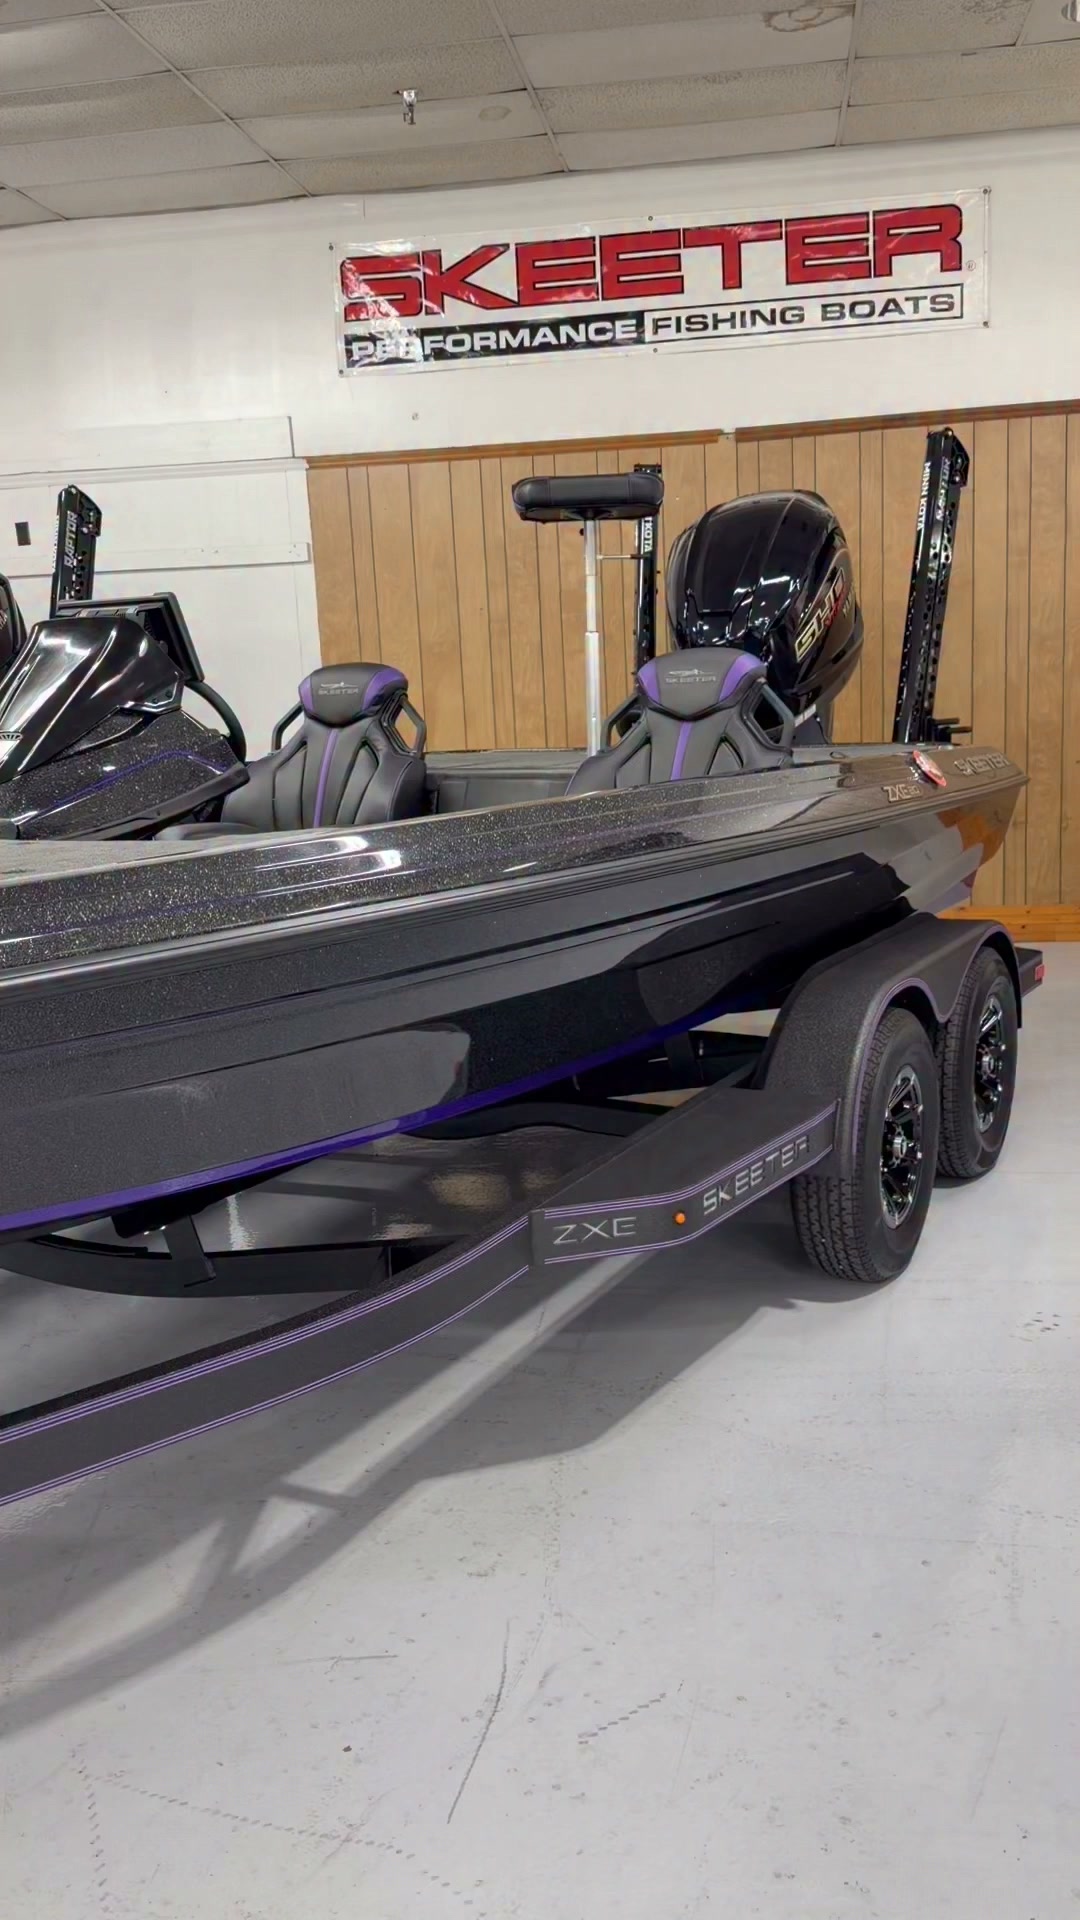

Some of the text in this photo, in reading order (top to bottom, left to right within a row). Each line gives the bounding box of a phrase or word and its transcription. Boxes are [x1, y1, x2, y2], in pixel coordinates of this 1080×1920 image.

[340, 203, 963, 322] SKEETER
[351, 293, 955, 361] PERFORMANCE FISHING BOATS
[917, 461, 931, 531] MINN KOTA
[63, 511, 78, 568] RAPTOR
[553, 1134, 810, 1245] ZXE SKEETER
